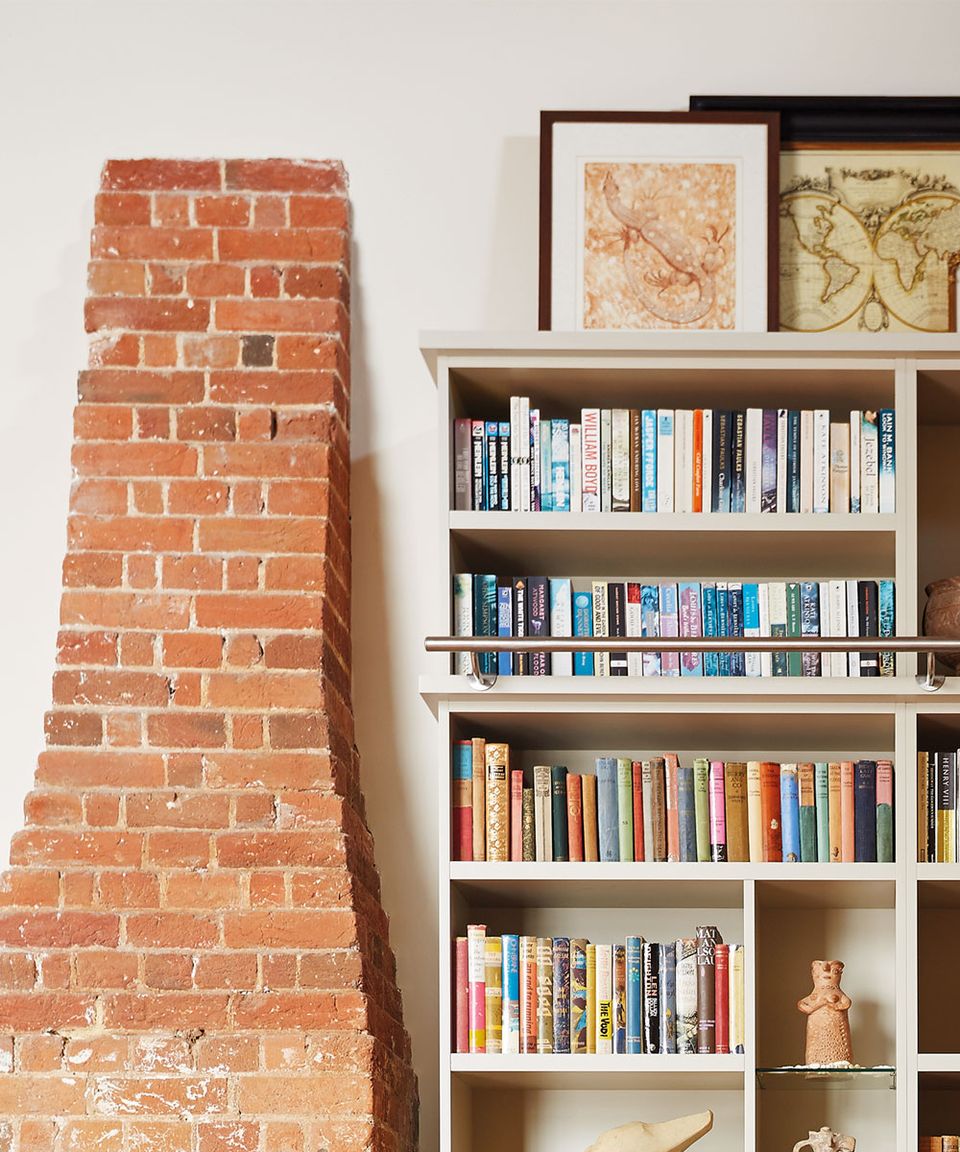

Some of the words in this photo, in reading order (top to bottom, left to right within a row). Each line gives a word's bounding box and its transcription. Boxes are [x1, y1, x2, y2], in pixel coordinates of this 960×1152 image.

[585, 412, 597, 462] WILLIAM
[864, 437, 874, 476] Jezebel
[585, 465, 597, 492] BOYD
[526, 990, 532, 998] to
[525, 1001, 533, 1034] running
[600, 1002, 610, 1016] THE
[600, 1018, 610, 1037] VODI
